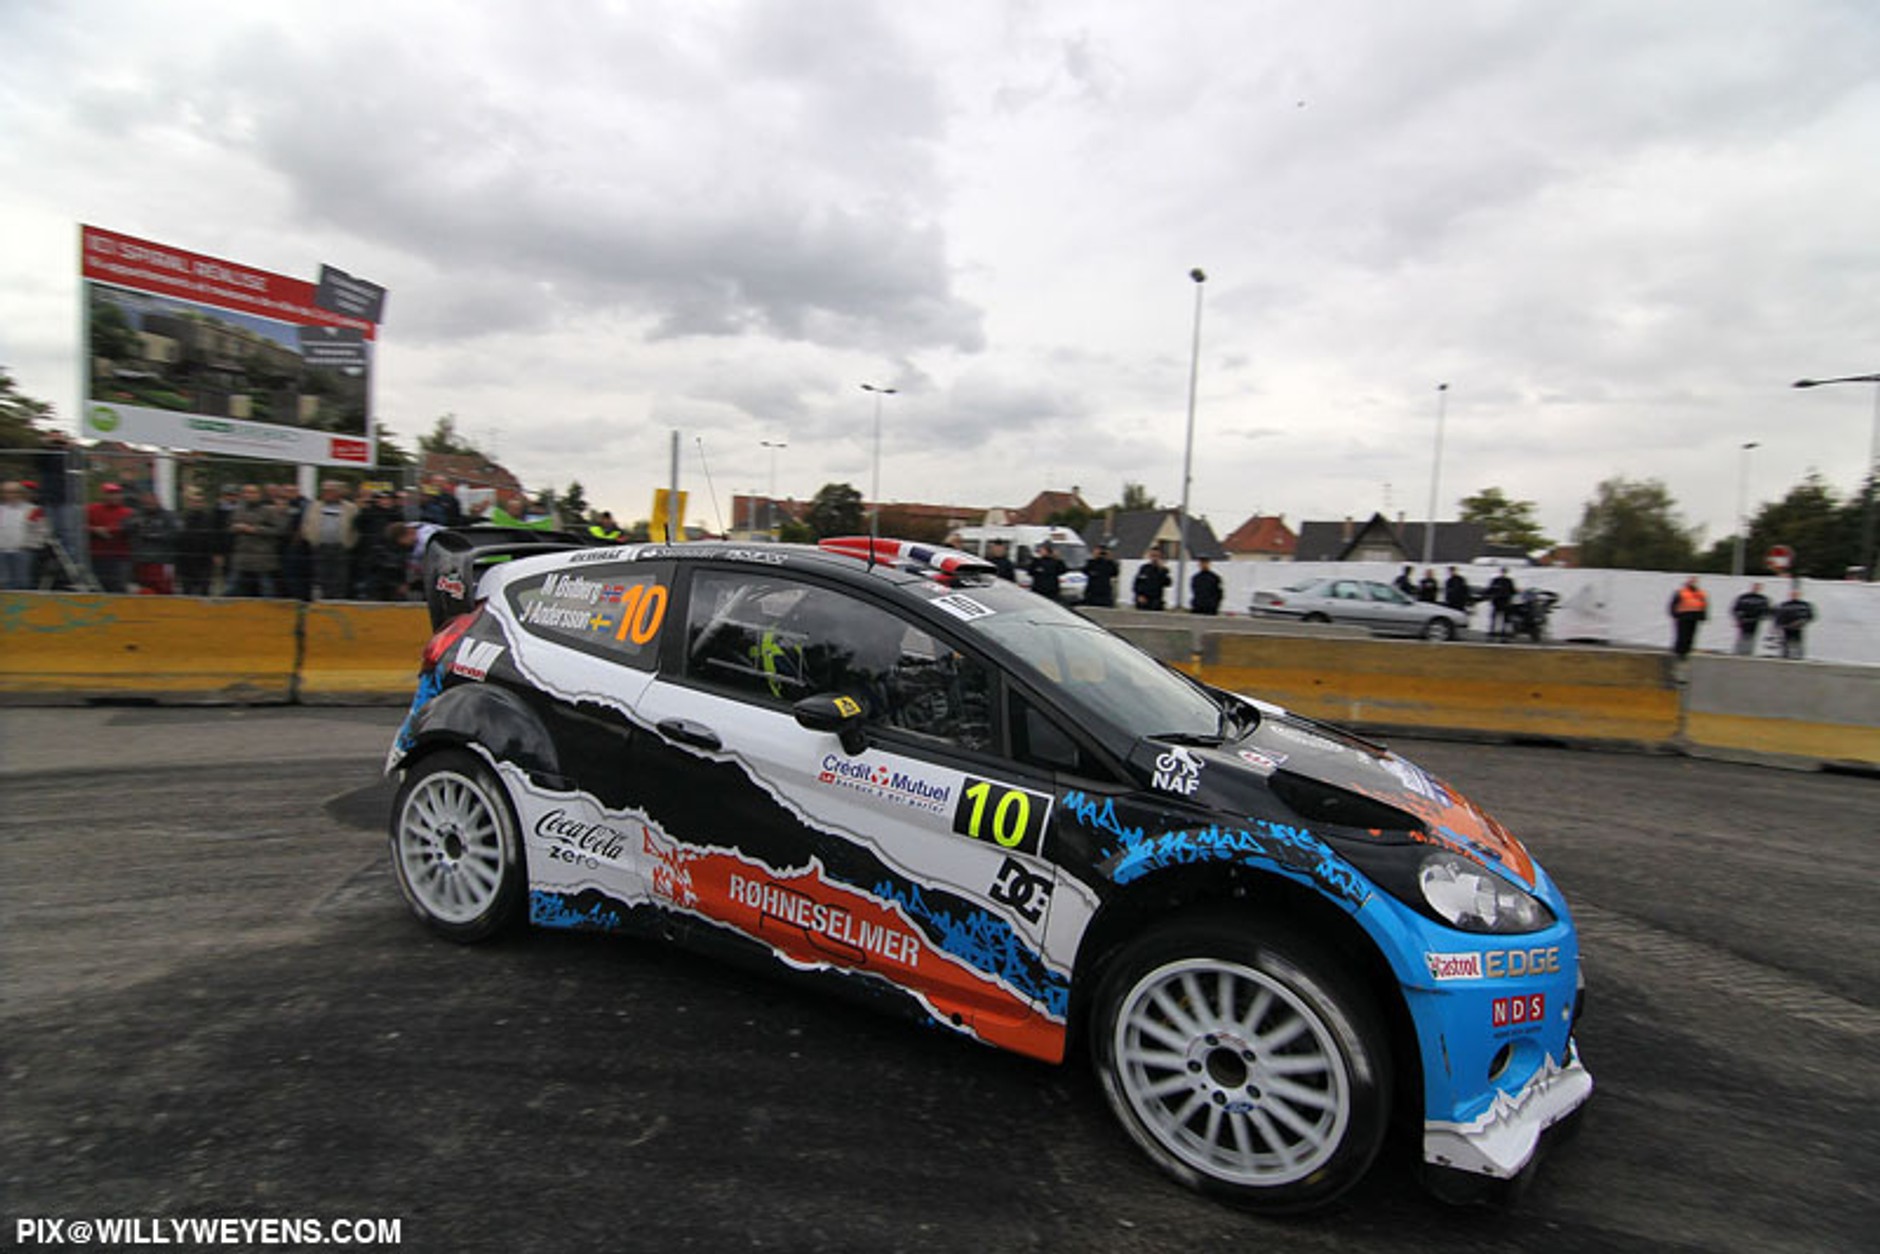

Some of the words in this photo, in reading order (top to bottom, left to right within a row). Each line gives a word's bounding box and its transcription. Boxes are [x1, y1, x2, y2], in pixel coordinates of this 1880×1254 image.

[519, 601, 533, 621] J
[529, 601, 590, 629] Andersson
[615, 584, 668, 645] 10
[822, 754, 871, 781] Crédit
[890, 772, 950, 802] Mutuel
[1152, 770, 1199, 795] NAF
[966, 781, 1030, 847] 10
[550, 845, 600, 870] zero
[729, 873, 920, 967] RØHNESELMER
[1431, 955, 1480, 977] Castrol
[1485, 947, 1560, 977] EDGE
